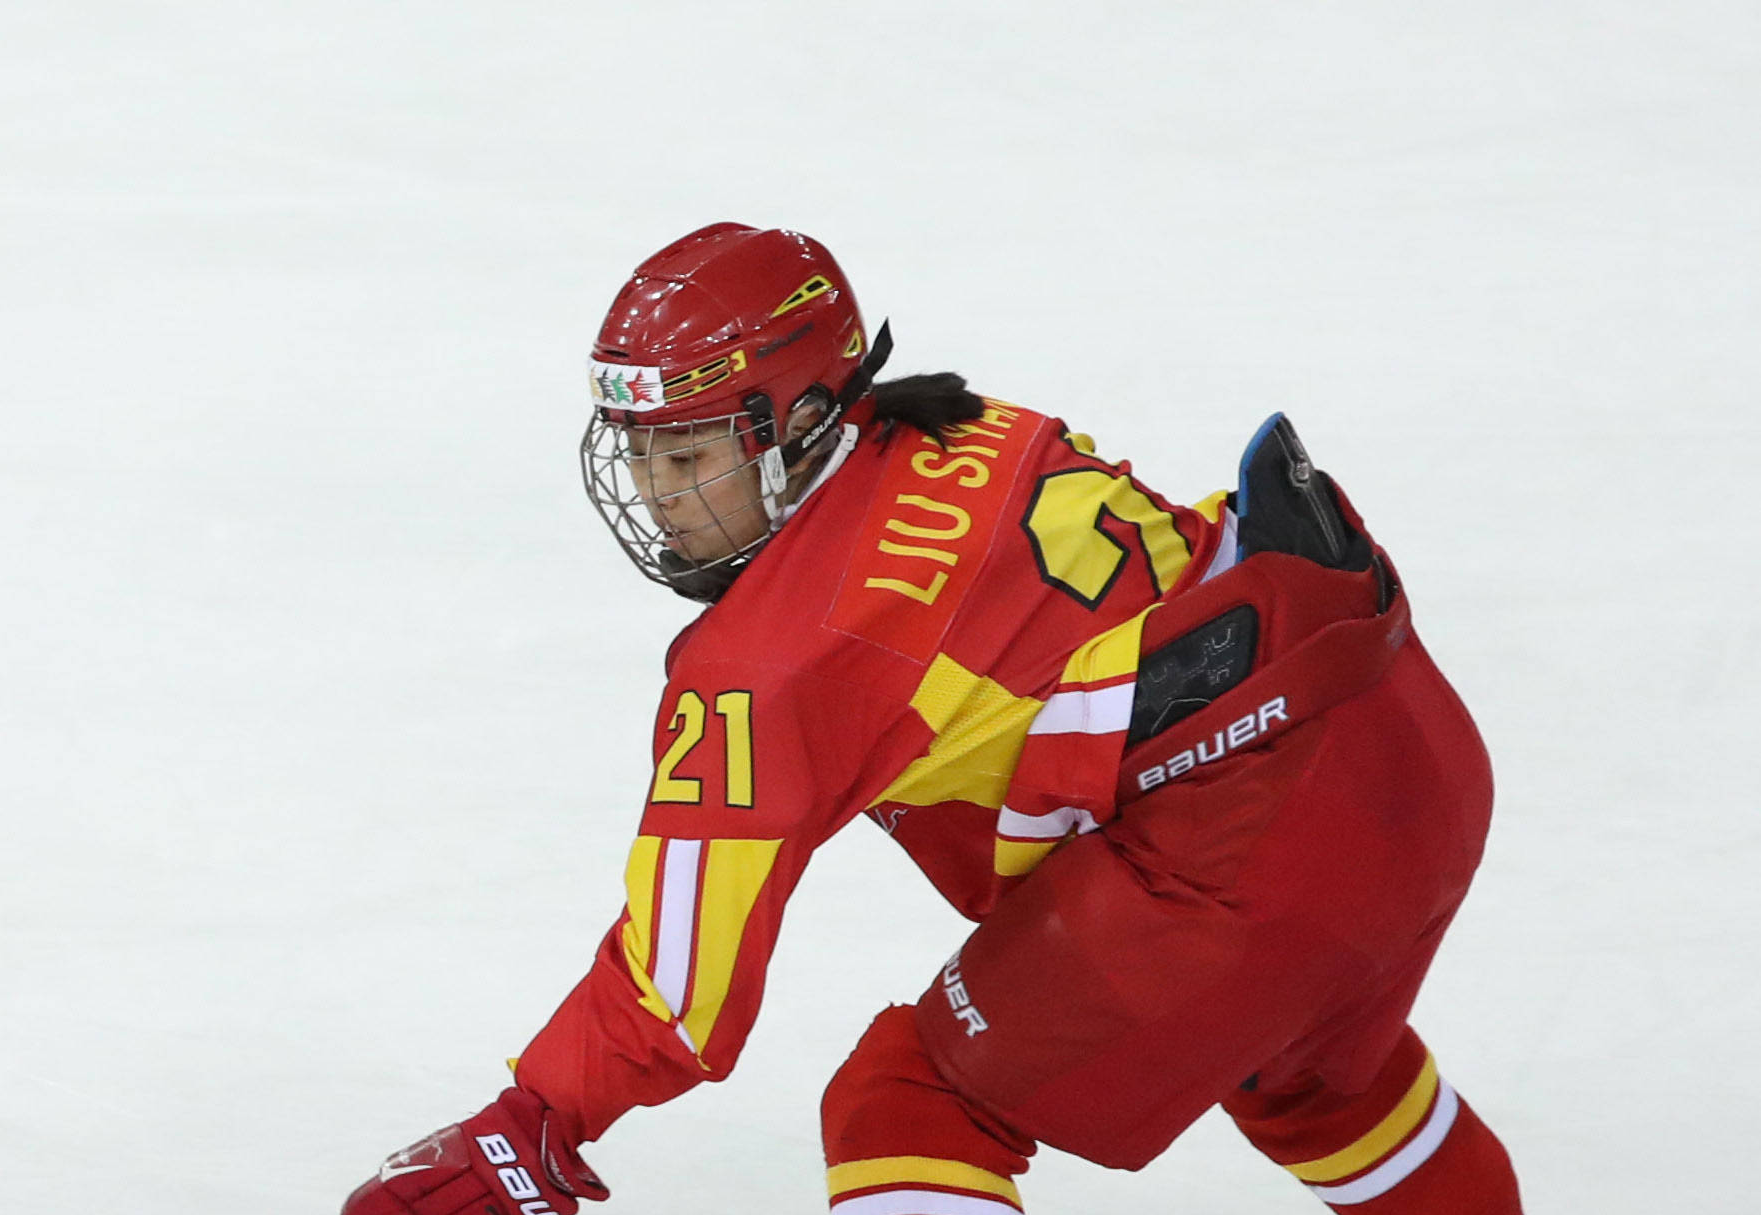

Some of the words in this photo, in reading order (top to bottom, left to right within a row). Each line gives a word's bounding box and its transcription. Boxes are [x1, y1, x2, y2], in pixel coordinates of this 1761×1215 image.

[864, 493, 972, 606] LIU
[1020, 428, 1196, 612] 2
[649, 688, 755, 810] 21
[1136, 694, 1291, 792] BAUER
[942, 949, 990, 1038] UER
